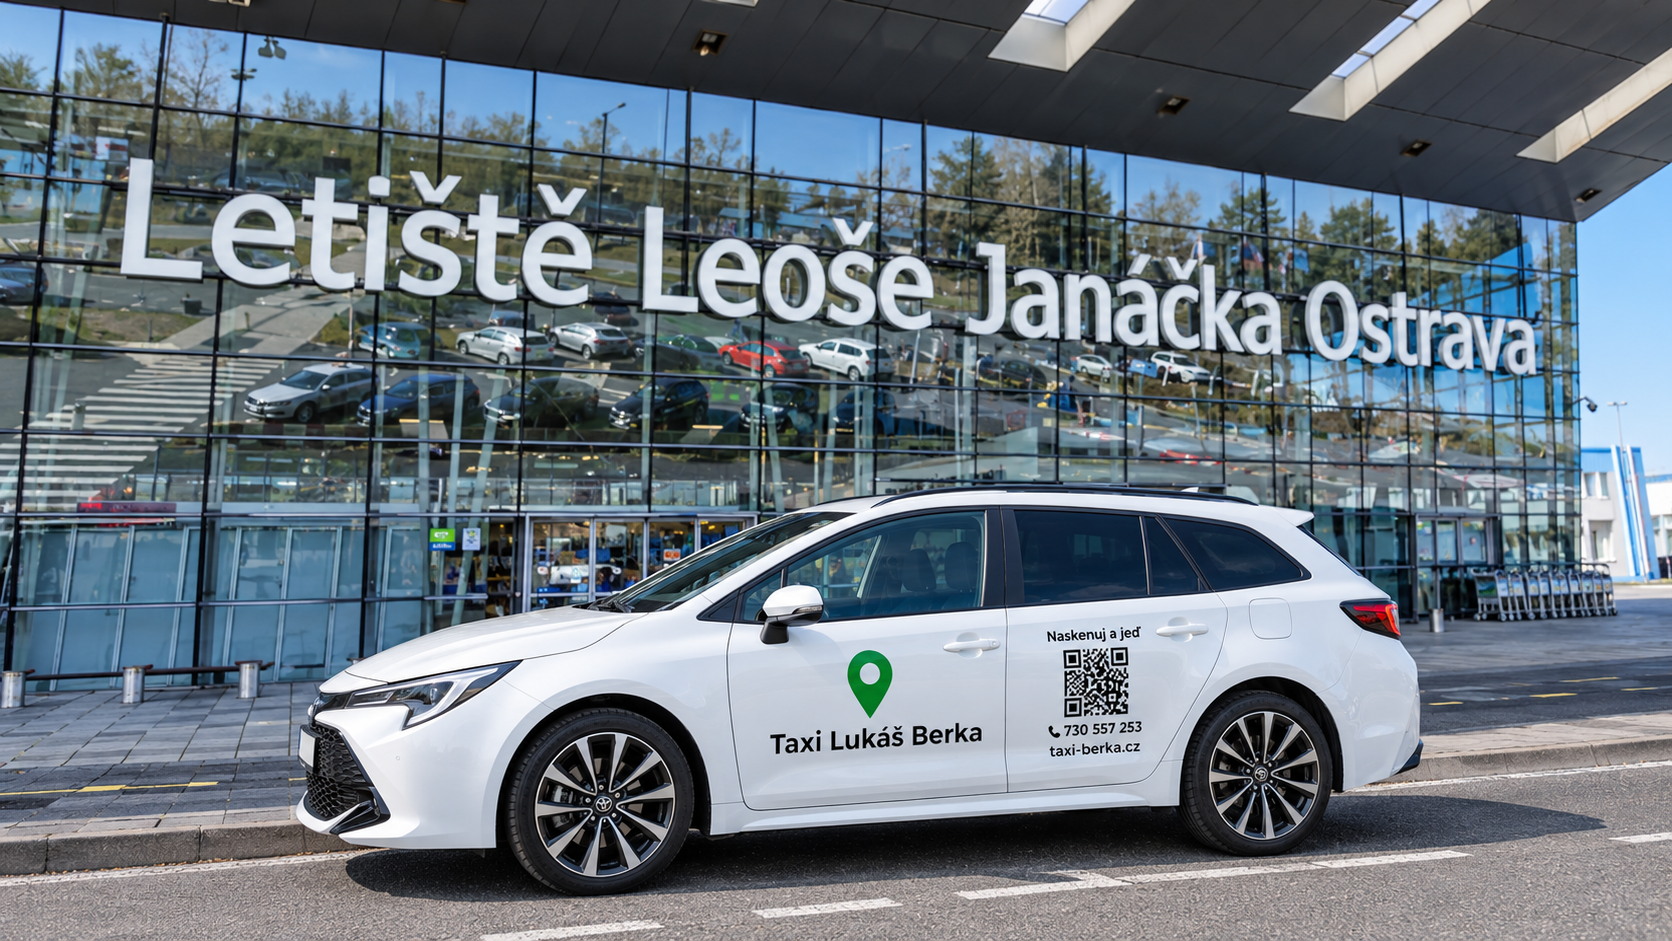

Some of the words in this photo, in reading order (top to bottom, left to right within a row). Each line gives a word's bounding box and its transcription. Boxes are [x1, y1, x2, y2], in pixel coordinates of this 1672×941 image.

[120, 158, 594, 306] Letiště
[642, 205, 935, 331] Leoše
[964, 241, 1283, 356] Janáčka
[1305, 280, 1537, 375] Ostrava
[1046, 628, 1106, 642] Naskenuj
[1109, 630, 1117, 640] a
[1120, 626, 1141, 641] jeď
[1064, 724, 1089, 736] 730
[1092, 723, 1116, 735] 557
[1118, 721, 1142, 734] 253
[769, 730, 822, 755] Taxi
[830, 725, 904, 751] Lukáš
[912, 723, 983, 747] Berka
[1049, 742, 1141, 757] taxi-berka.cz
